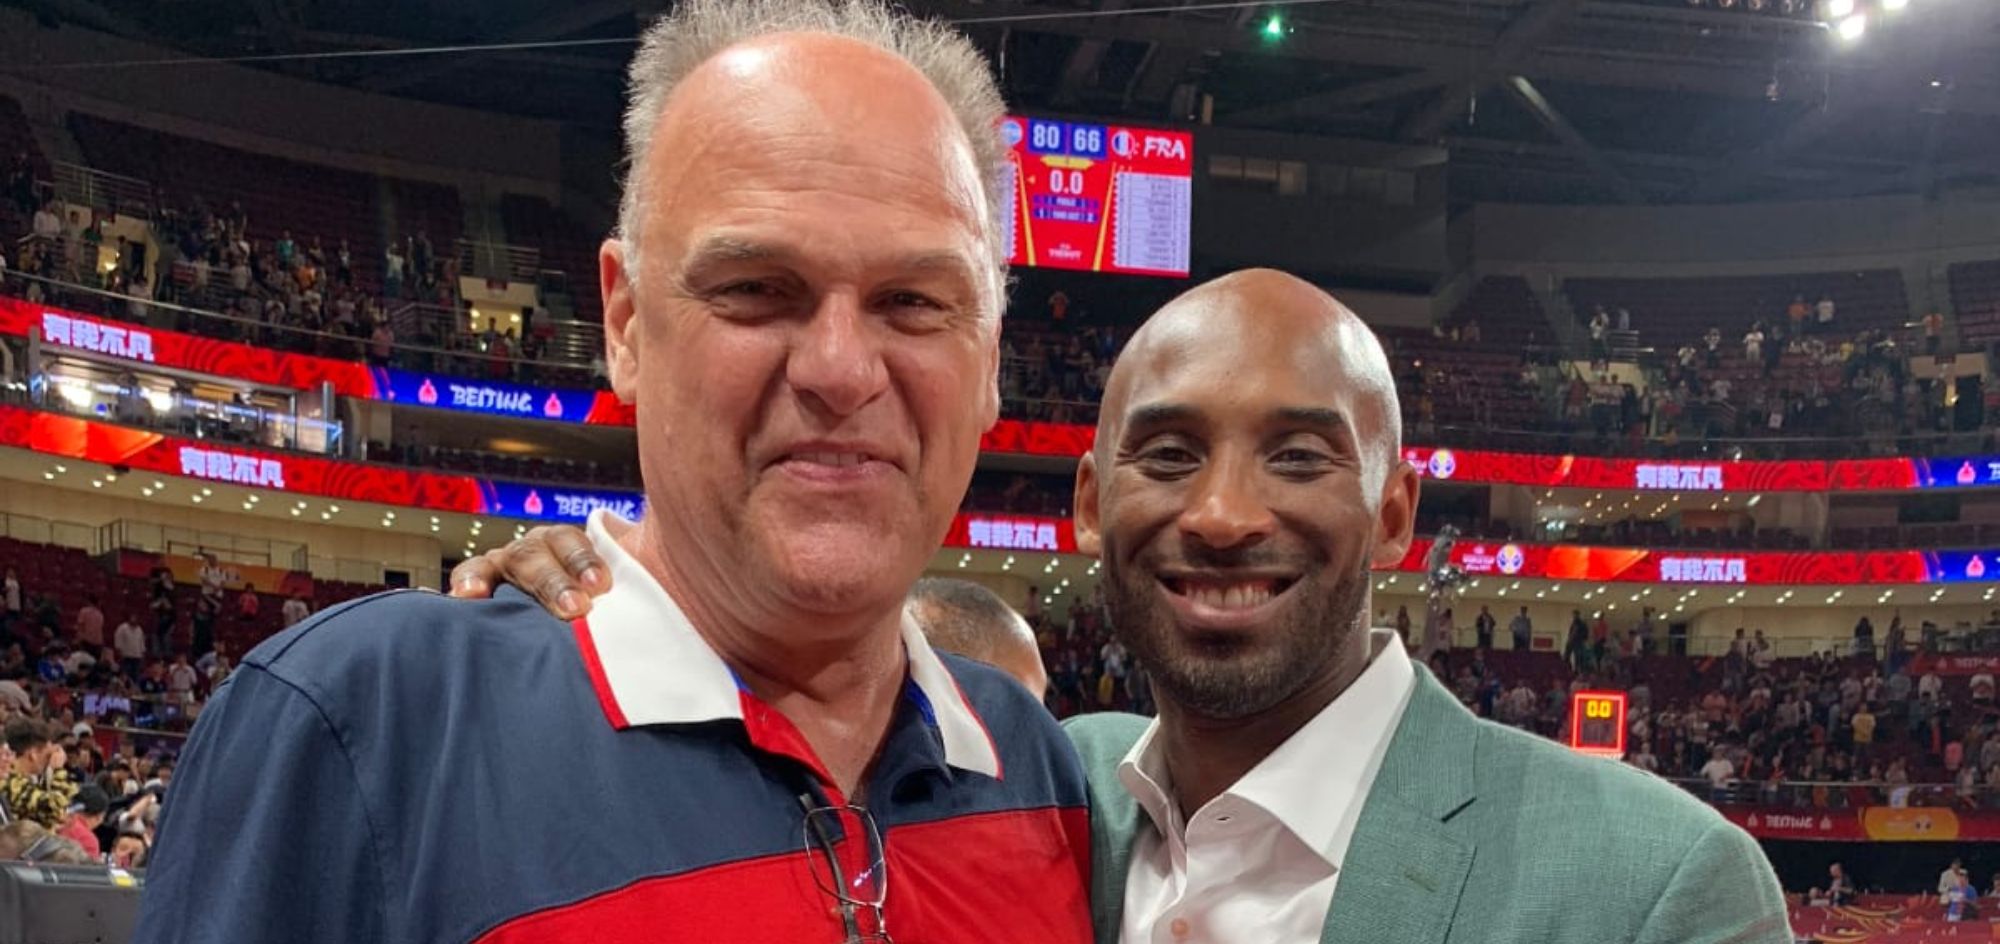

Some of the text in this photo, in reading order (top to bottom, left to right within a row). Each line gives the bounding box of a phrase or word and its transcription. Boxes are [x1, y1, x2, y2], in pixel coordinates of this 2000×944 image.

[1033, 124, 1060, 149] 80
[1074, 128, 1100, 152] 66
[1143, 135, 1186, 160] FRA
[1050, 169, 1083, 195] 0.0
[43, 313, 154, 361] 有我不凡
[179, 447, 285, 488] 有我不凡
[1636, 465, 1723, 489] 有我不凡
[968, 520, 1058, 550] 有我不凡
[1660, 558, 1747, 582] 有我不凡
